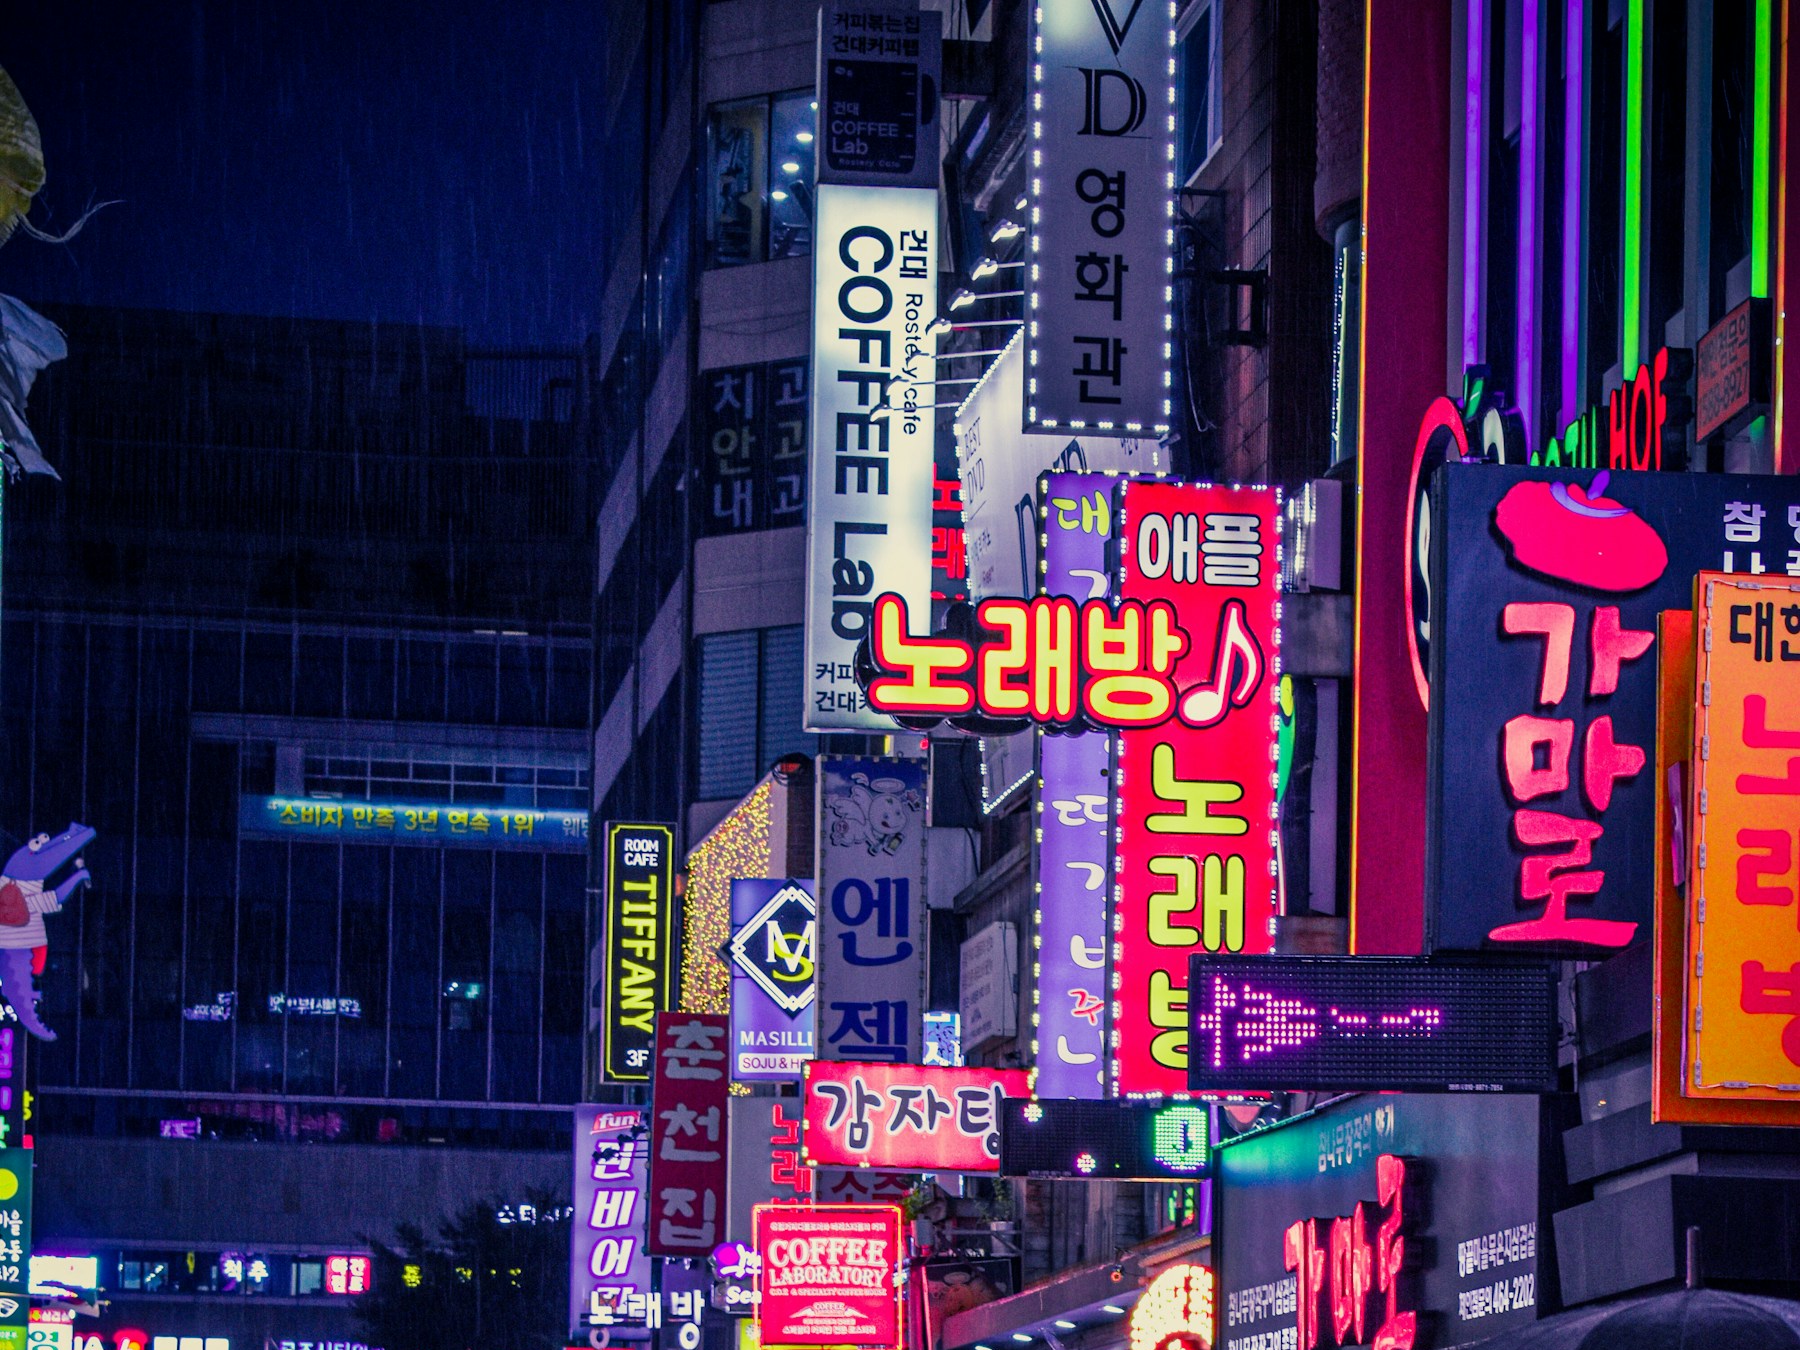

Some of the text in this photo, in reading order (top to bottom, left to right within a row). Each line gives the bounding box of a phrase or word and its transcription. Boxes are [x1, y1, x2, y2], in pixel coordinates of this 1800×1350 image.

[831, 120, 899, 138] COFFEE
[833, 102, 860, 116] 건대
[832, 137, 869, 155] Lab
[899, 230, 928, 279] 건대
[1072, 168, 1129, 405] 영화관
[1609, 346, 1668, 471] HOF
[830, 225, 895, 641] COFFEE Lab
[966, 457, 985, 505] DVD
[1138, 512, 1263, 587] 애플
[869, 593, 1189, 726] 노래방
[1488, 602, 1656, 948] 가마로
[352, 808, 396, 830] 만족
[404, 809, 439, 832] 3년
[447, 811, 491, 834] 연속
[624, 838, 660, 853] ROOM
[624, 853, 659, 867] CAFE
[620, 875, 658, 1034] TIFFANY
[625, 1049, 650, 1067] 3F
[742, 1057, 777, 1069] SOJU
[778, 1057, 788, 1069] &
[657, 1020, 726, 1247] 춘천집
[814, 1077, 1000, 1156] 감자탕
[767, 1237, 889, 1268] COFFEE
[767, 1265, 890, 1288] LABORATORY
[588, 1289, 706, 1350] 노래방
